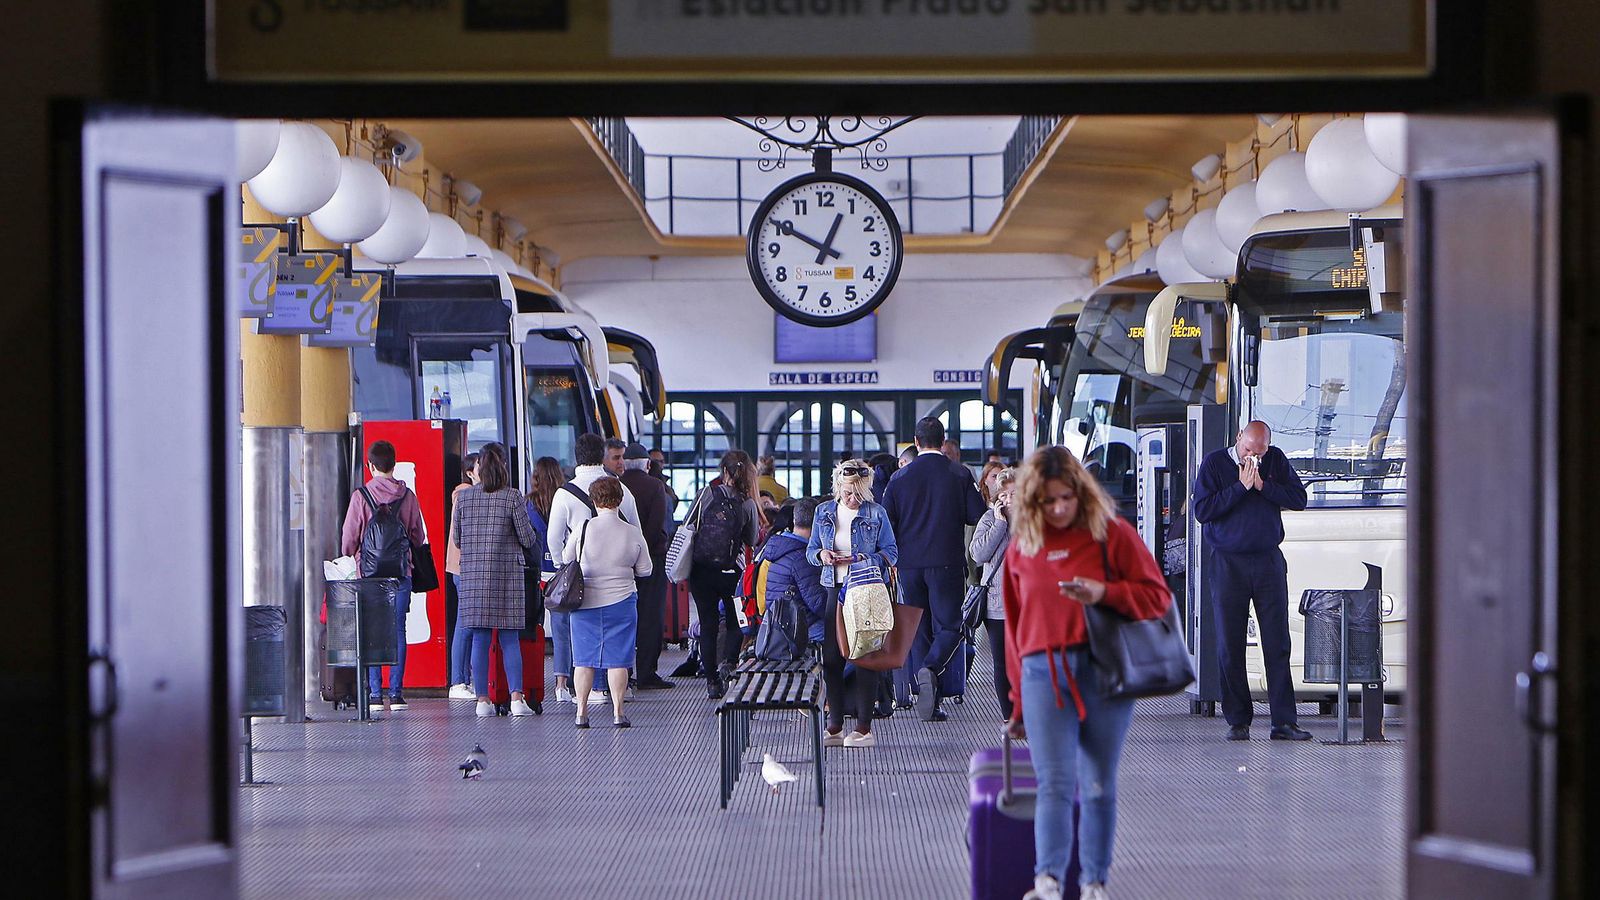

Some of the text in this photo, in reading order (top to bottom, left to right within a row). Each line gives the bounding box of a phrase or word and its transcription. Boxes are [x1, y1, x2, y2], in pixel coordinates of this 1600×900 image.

[793, 200, 808, 215] 11
[816, 191, 835, 208] 12
[848, 199, 855, 214] 1
[863, 216, 875, 232] 2
[768, 242, 781, 258] 9
[869, 241, 882, 257] 3
[775, 266, 787, 282] 8
[863, 266, 875, 282] 4
[1332, 268, 1369, 288] CHIP
[797, 286, 808, 301] 7
[819, 292, 832, 308] 6
[844, 286, 857, 301] 5
[1170, 326, 1202, 338] GECIRA
[770, 371, 878, 384] SALA DE ESPERA
[934, 370, 982, 382] CONSIG
